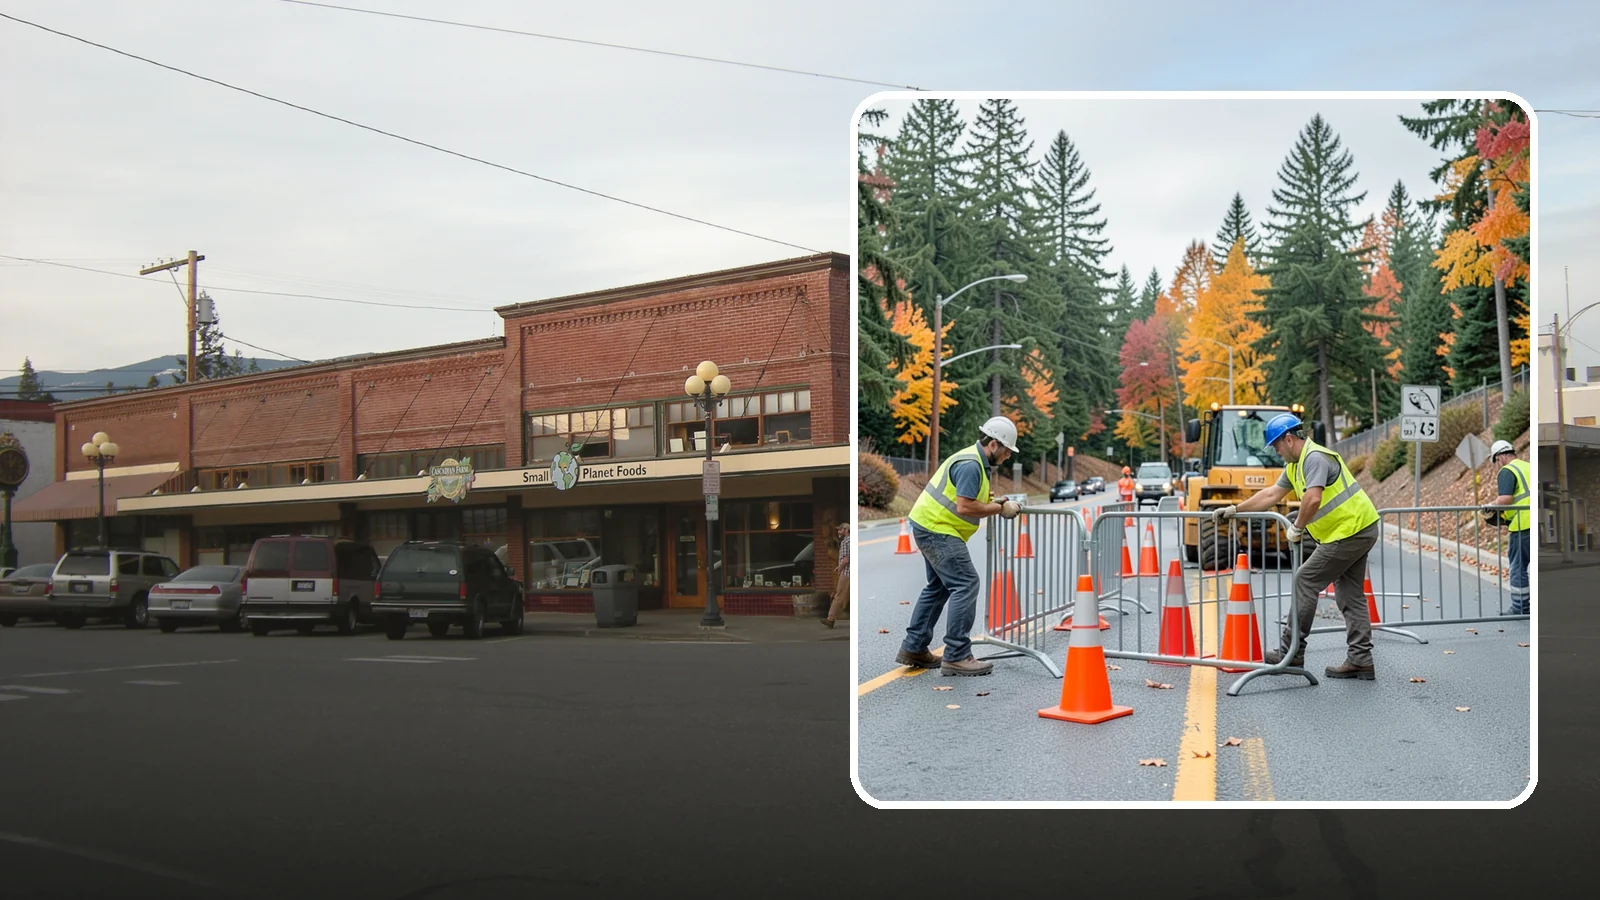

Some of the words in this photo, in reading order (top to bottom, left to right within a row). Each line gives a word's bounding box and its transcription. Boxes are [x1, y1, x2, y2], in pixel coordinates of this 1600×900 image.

[431, 467, 456, 476] CASCADIAN
[455, 466, 469, 474] FARM
[523, 471, 549, 483] Small
[582, 467, 614, 479] Planet
[616, 464, 647, 477] Foods
